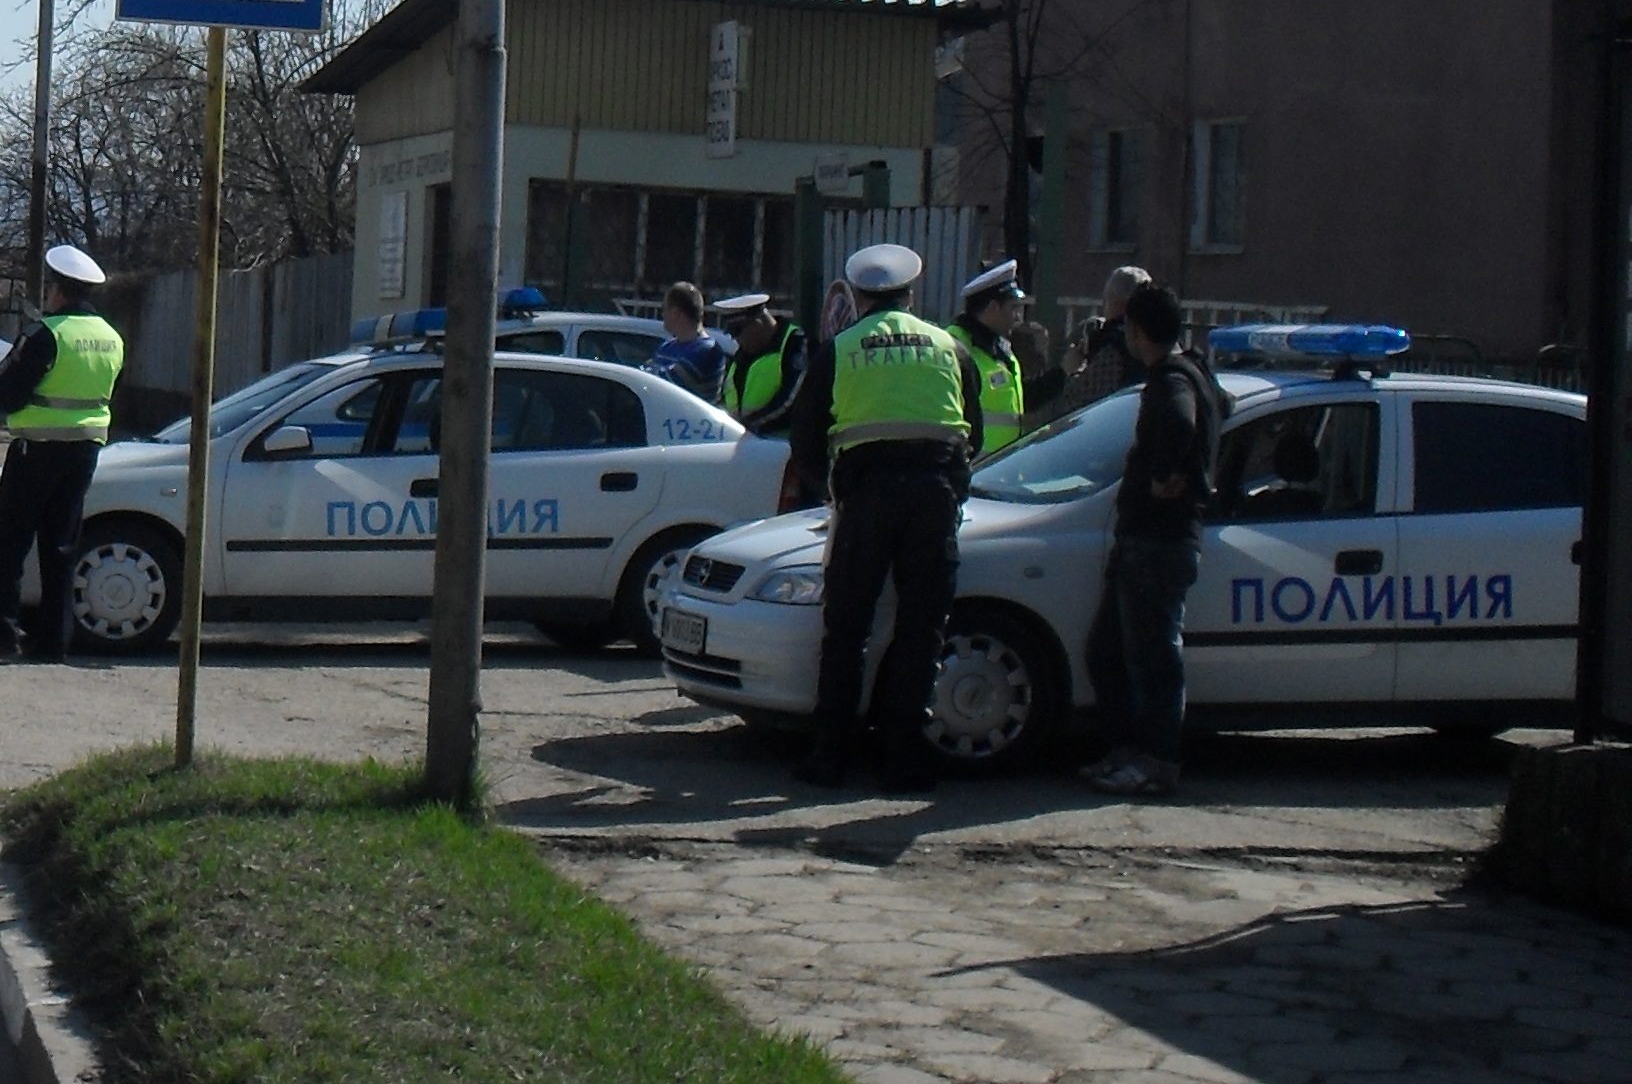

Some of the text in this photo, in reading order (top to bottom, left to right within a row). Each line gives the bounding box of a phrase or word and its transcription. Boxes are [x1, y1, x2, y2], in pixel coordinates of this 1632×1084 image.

[848, 346, 954, 371] TRAFFIC
[326, 498, 559, 538] ПОЛИЯ
[1231, 574, 1513, 626] ПОЛИЦИЯ
